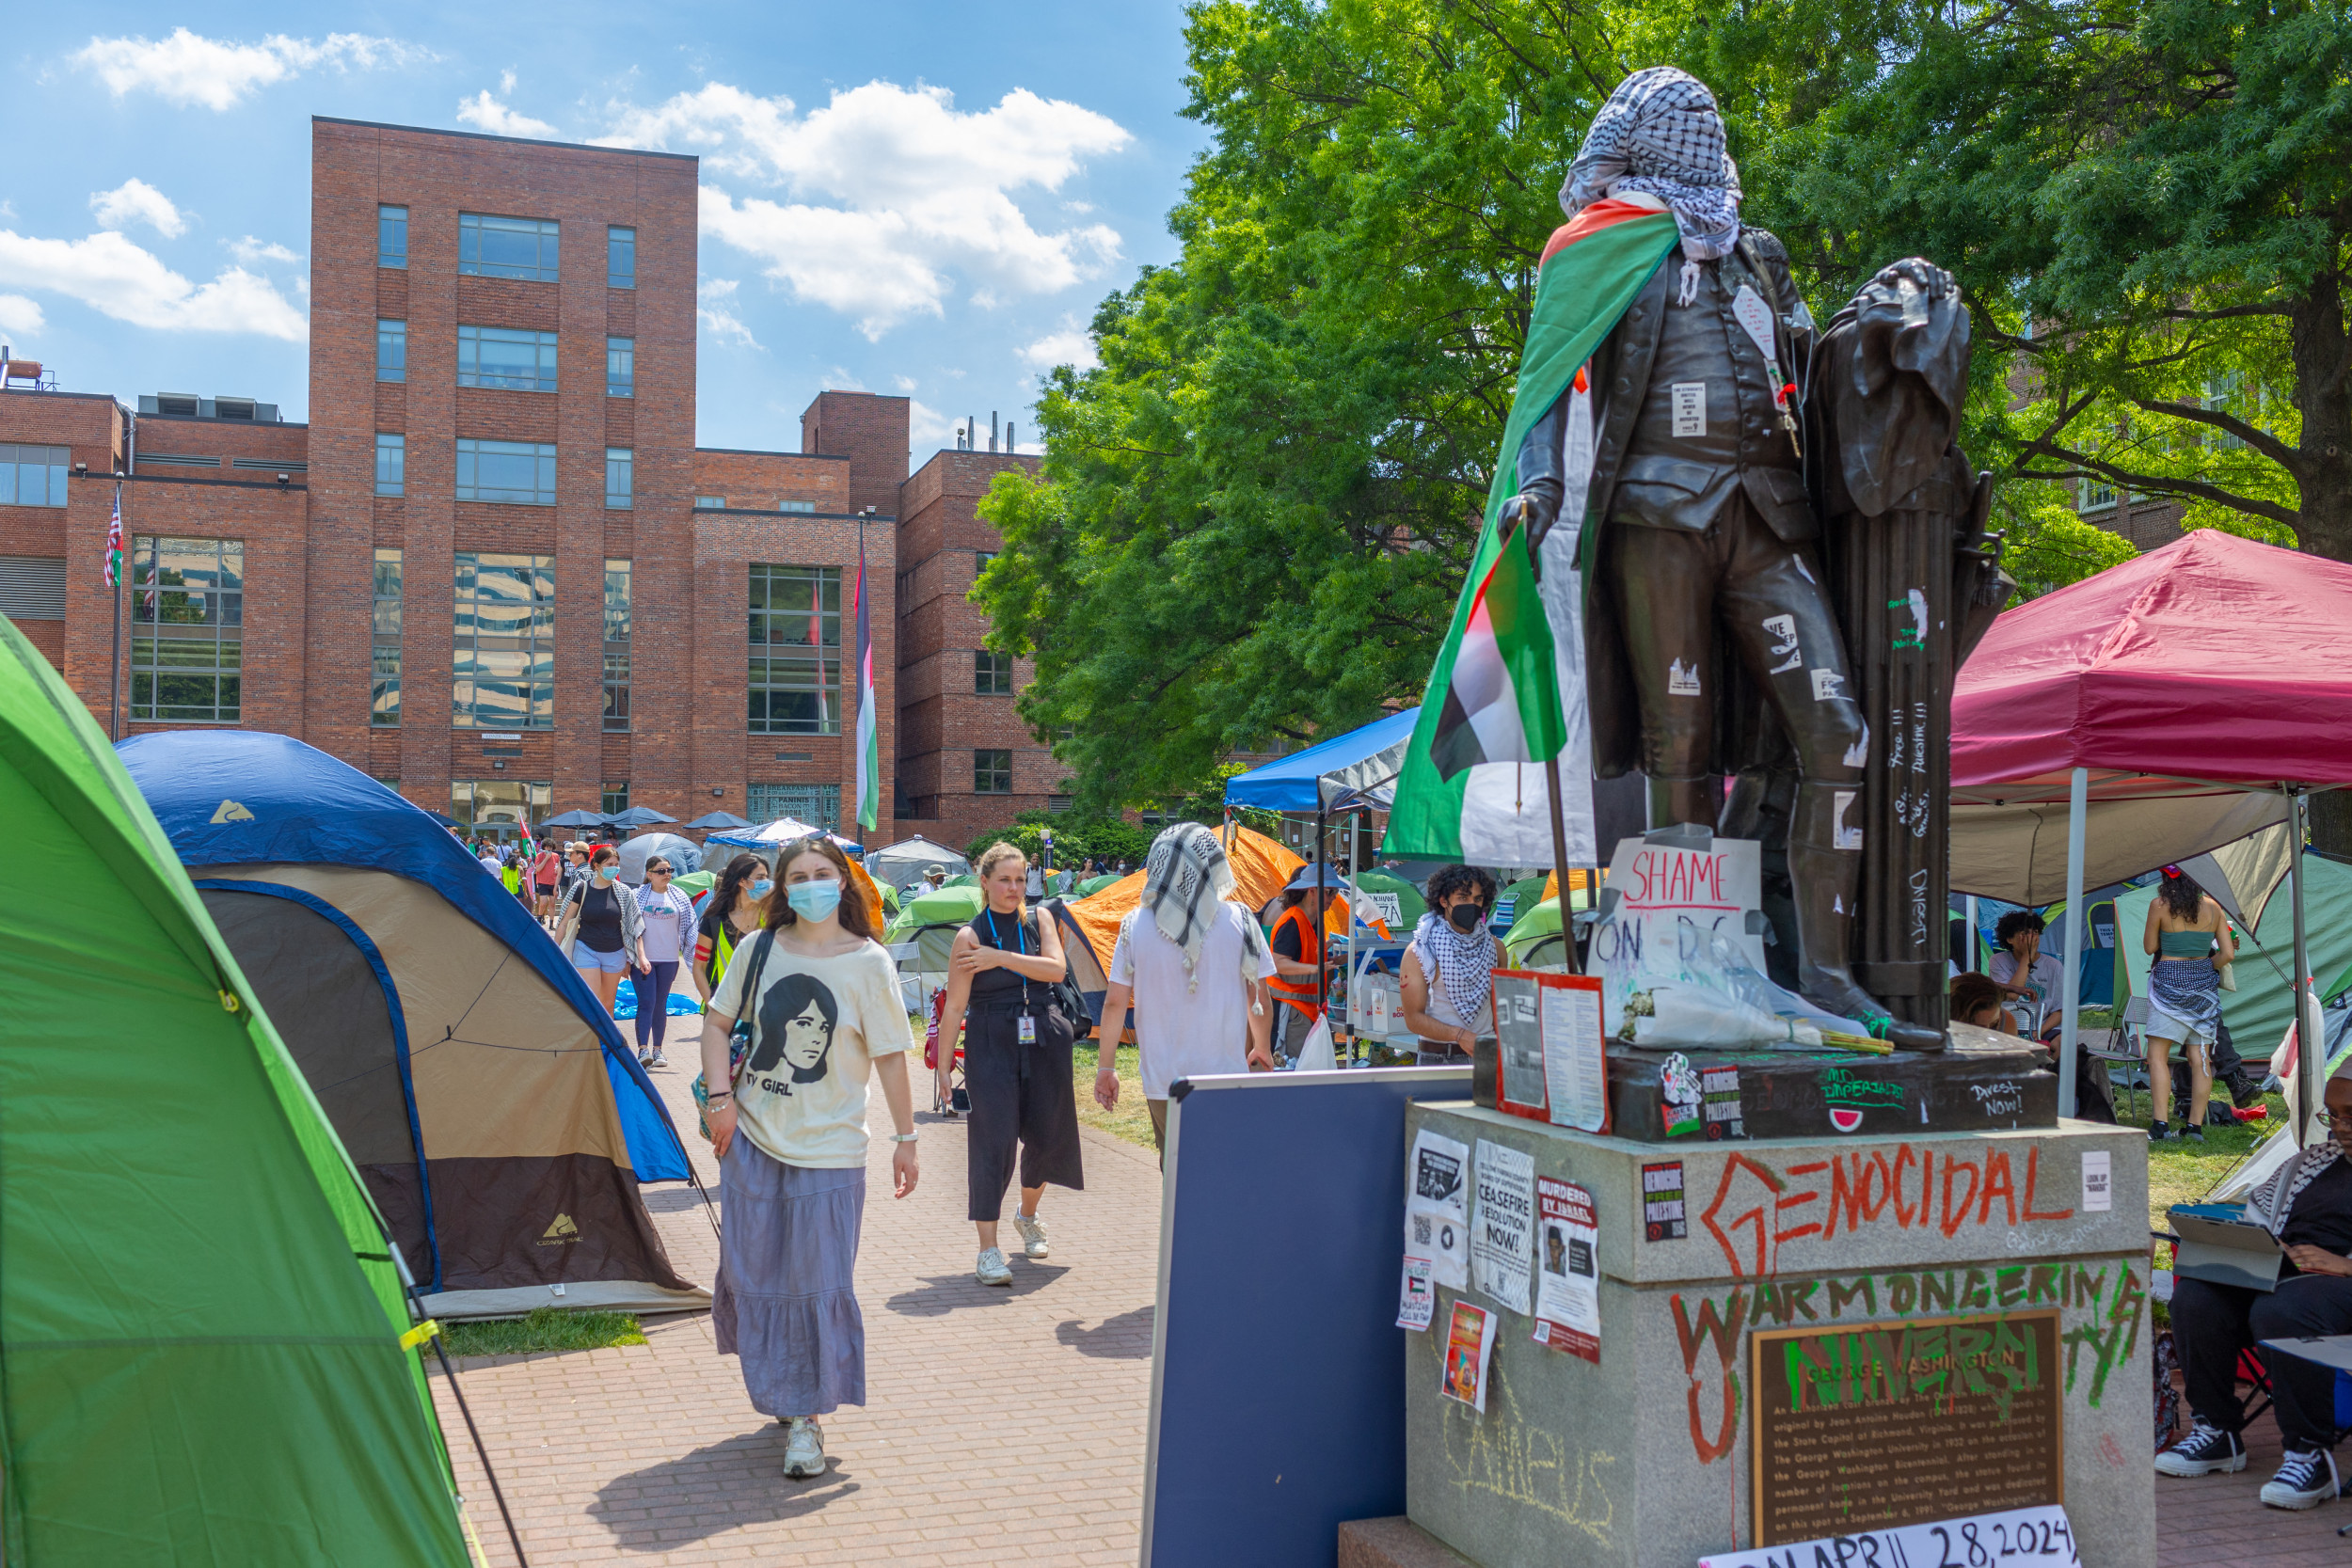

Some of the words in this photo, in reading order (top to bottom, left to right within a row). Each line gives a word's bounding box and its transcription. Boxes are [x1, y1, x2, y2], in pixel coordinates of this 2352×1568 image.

[1623, 850, 1729, 902] SHAME
[1596, 915, 1641, 962] ON
[761, 1078, 793, 1097] GIRL
[1706, 1091, 1740, 1103] FREE
[1478, 1183, 1530, 1216] CEASEFIRE
[1538, 1179, 1592, 1208] MURDERED
[1645, 1190, 1683, 1203] FREE
[1481, 1205, 1526, 1233] RESOLUTION
[1543, 1197, 1556, 1212] BY
[1557, 1202, 1593, 1221] ISRAEL
[1646, 1199, 1685, 1223] PALESTINE
[1700, 1142, 2074, 1277] GENOCIDAL
[1486, 1224, 1519, 1253] NOW!
[1669, 1259, 2145, 1375] WARMONGERING
[1773, 1406, 1787, 1415] An
[1915, 1392, 1930, 1402] The
[1773, 1419, 1810, 1433] original
[1814, 1418, 1825, 1430] by
[1830, 1417, 1851, 1427] Jean
[1854, 1413, 1889, 1424] Antoine
[1892, 1410, 1926, 1421] Houdon
[1773, 1437, 1789, 1449] the
[1793, 1436, 1818, 1448] State
[1820, 1432, 1854, 1446] Capitol
[1969, 1420, 1986, 1429] was
[1774, 1454, 1791, 1465] The
[1794, 1451, 1829, 1464] George
[1832, 1446, 1884, 1459] Washington
[1887, 1442, 1930, 1454] University
[1773, 1470, 1790, 1481] the
[1796, 1468, 1831, 1480] George
[1836, 1462, 1889, 1475] Washington
[1774, 1486, 1810, 1498] number
[1815, 1483, 1825, 1494] of
[1876, 1480, 1889, 1488] on
[1894, 1476, 1909, 1486] the
[1955, 1469, 1970, 1479] the
[1774, 1502, 1824, 1517] permanent
[1857, 1497, 1867, 1506] in
[1871, 1495, 1887, 1505] the
[1890, 1489, 1933, 1503] University
[1963, 1483, 1980, 1495] and
[1984, 1482, 2002, 1492] was
[1791, 1520, 1808, 1529] this
[1812, 1517, 1832, 1529] spot
[1850, 1510, 1899, 1524] September
